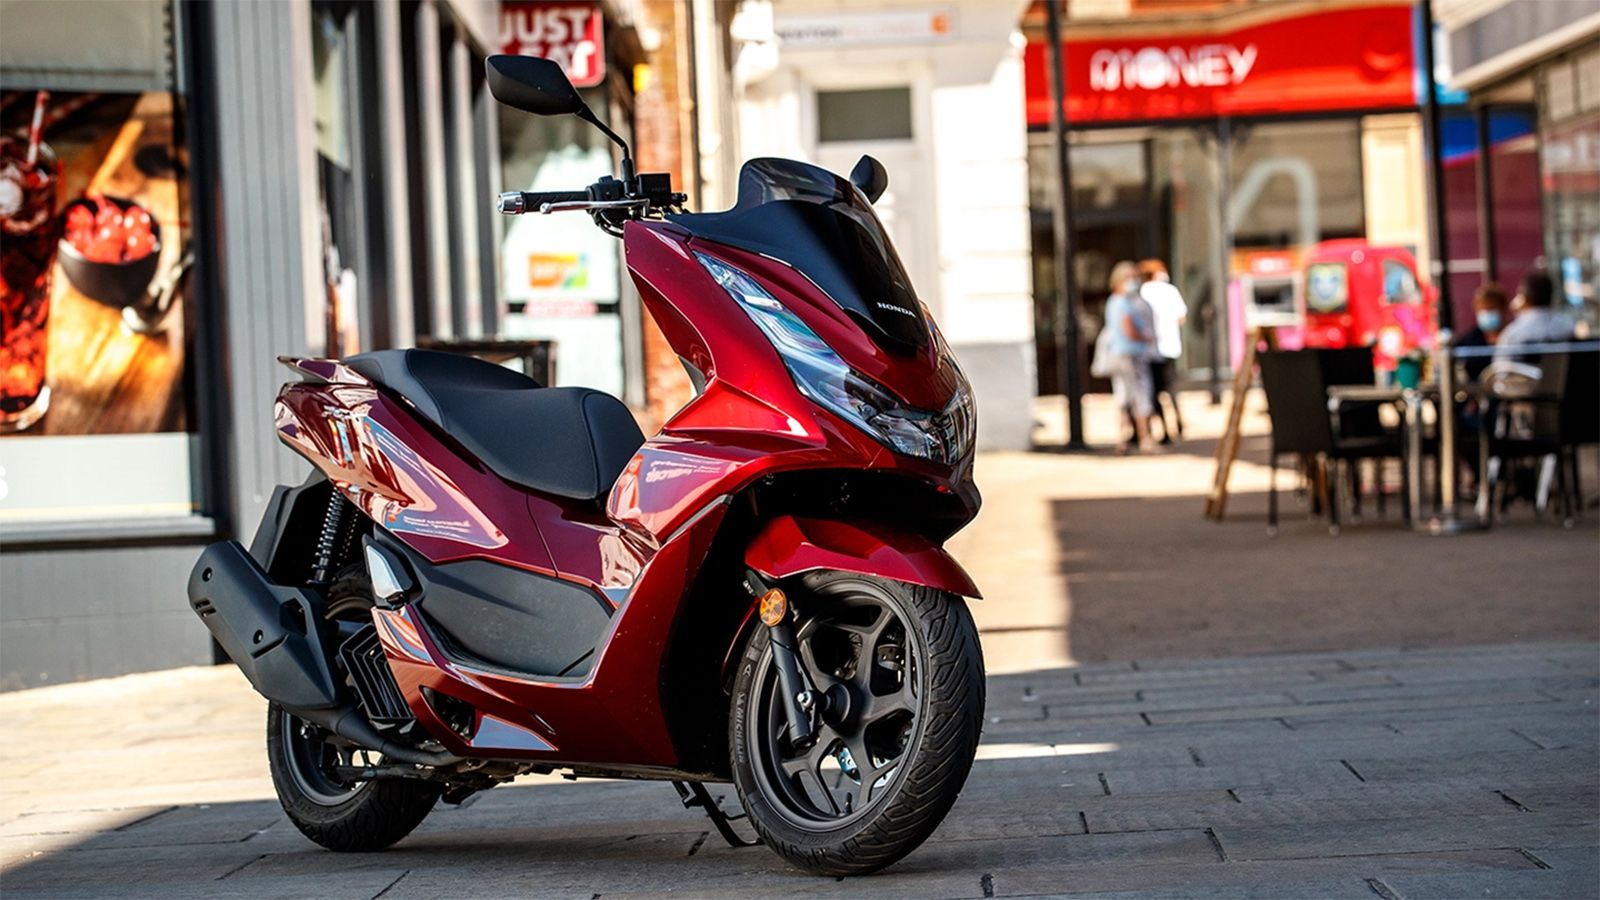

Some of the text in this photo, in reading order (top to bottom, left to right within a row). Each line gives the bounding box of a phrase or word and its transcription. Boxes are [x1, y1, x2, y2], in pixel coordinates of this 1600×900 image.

[500, 8, 591, 43] JUST
[1090, 43, 1258, 91] MONEY
[877, 302, 916, 318] HONDA
